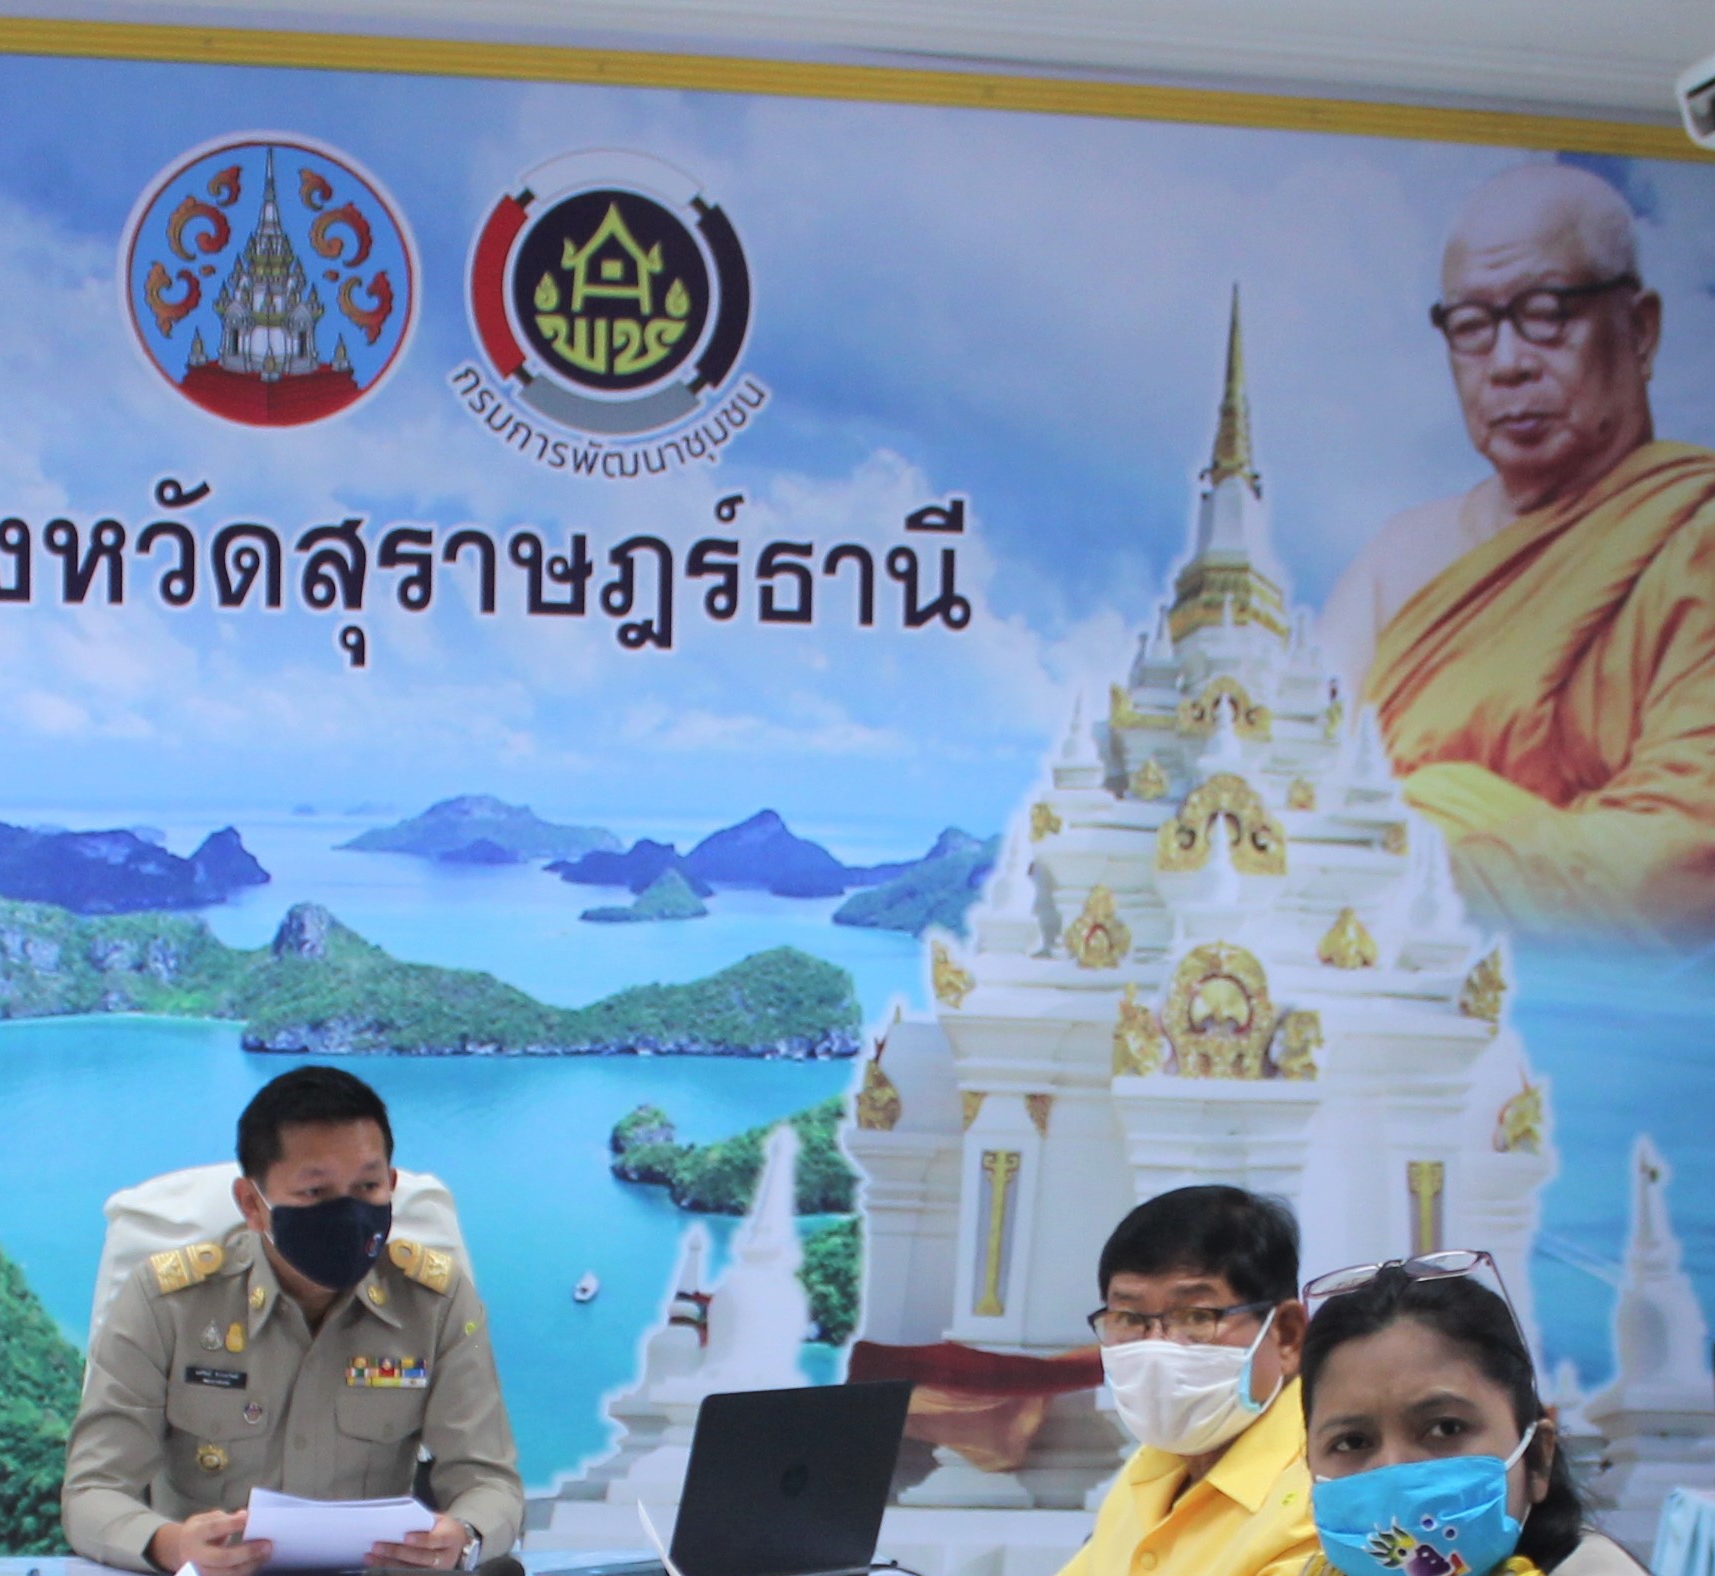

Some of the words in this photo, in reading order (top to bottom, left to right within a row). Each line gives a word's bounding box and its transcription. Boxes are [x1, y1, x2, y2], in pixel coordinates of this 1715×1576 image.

[451, 365, 767, 478] กรมการพัฒนาชุมชน
